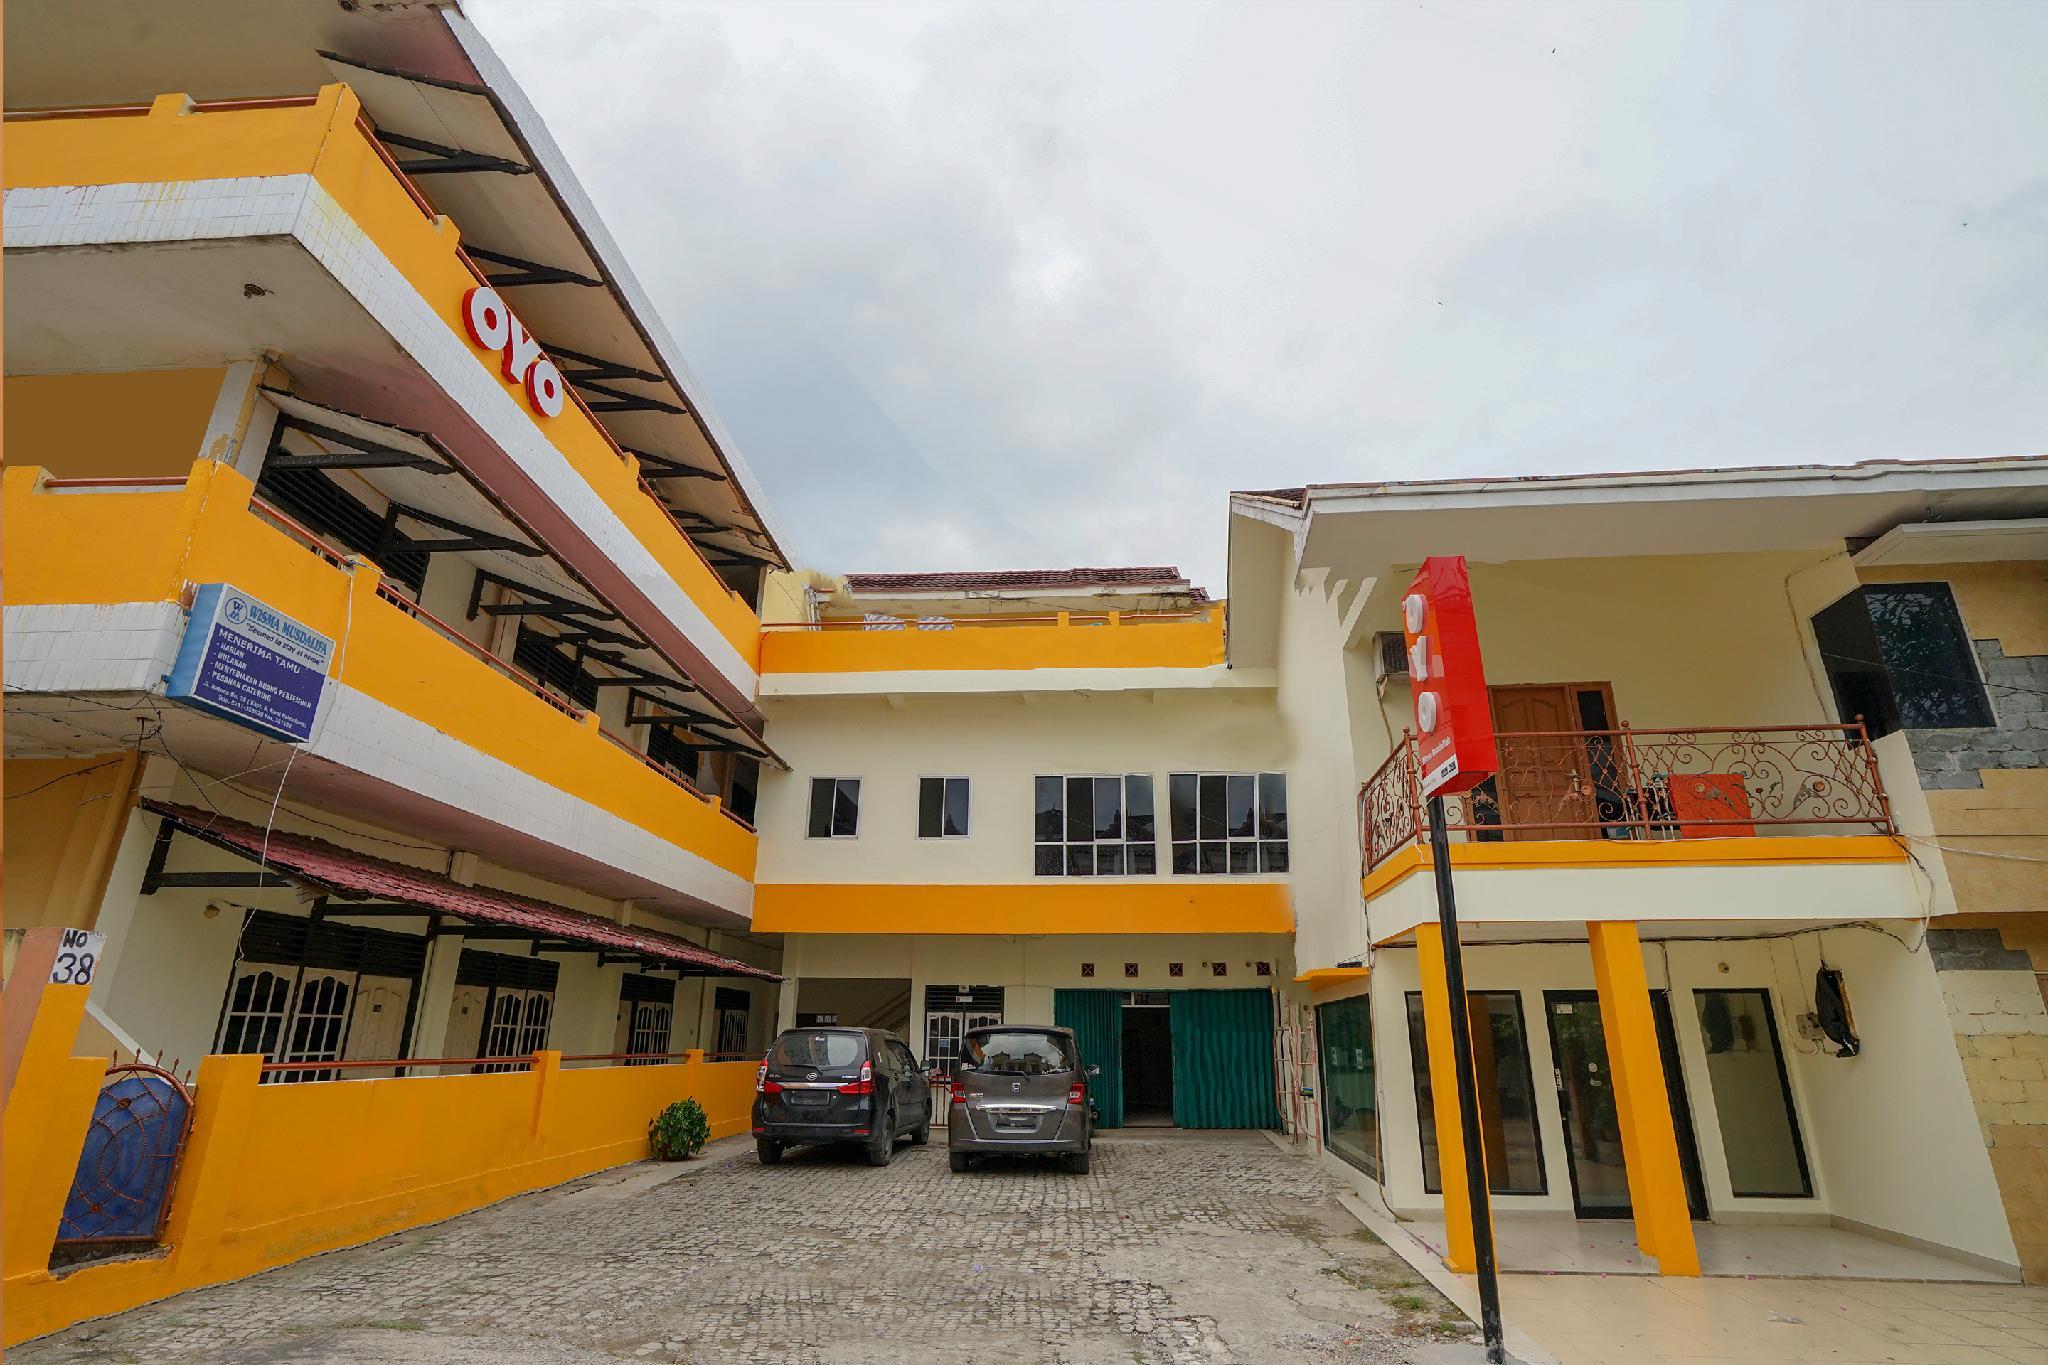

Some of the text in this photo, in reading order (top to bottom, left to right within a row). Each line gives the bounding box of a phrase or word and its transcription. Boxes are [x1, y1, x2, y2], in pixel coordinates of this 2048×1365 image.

[462, 286, 564, 417] OYO
[249, 605, 281, 631] WISMA
[218, 628, 301, 675] MENERIMA TAMU
[220, 642, 245, 659] HARIAN
[241, 684, 272, 702] CATERING
[53, 952, 94, 985] 38
